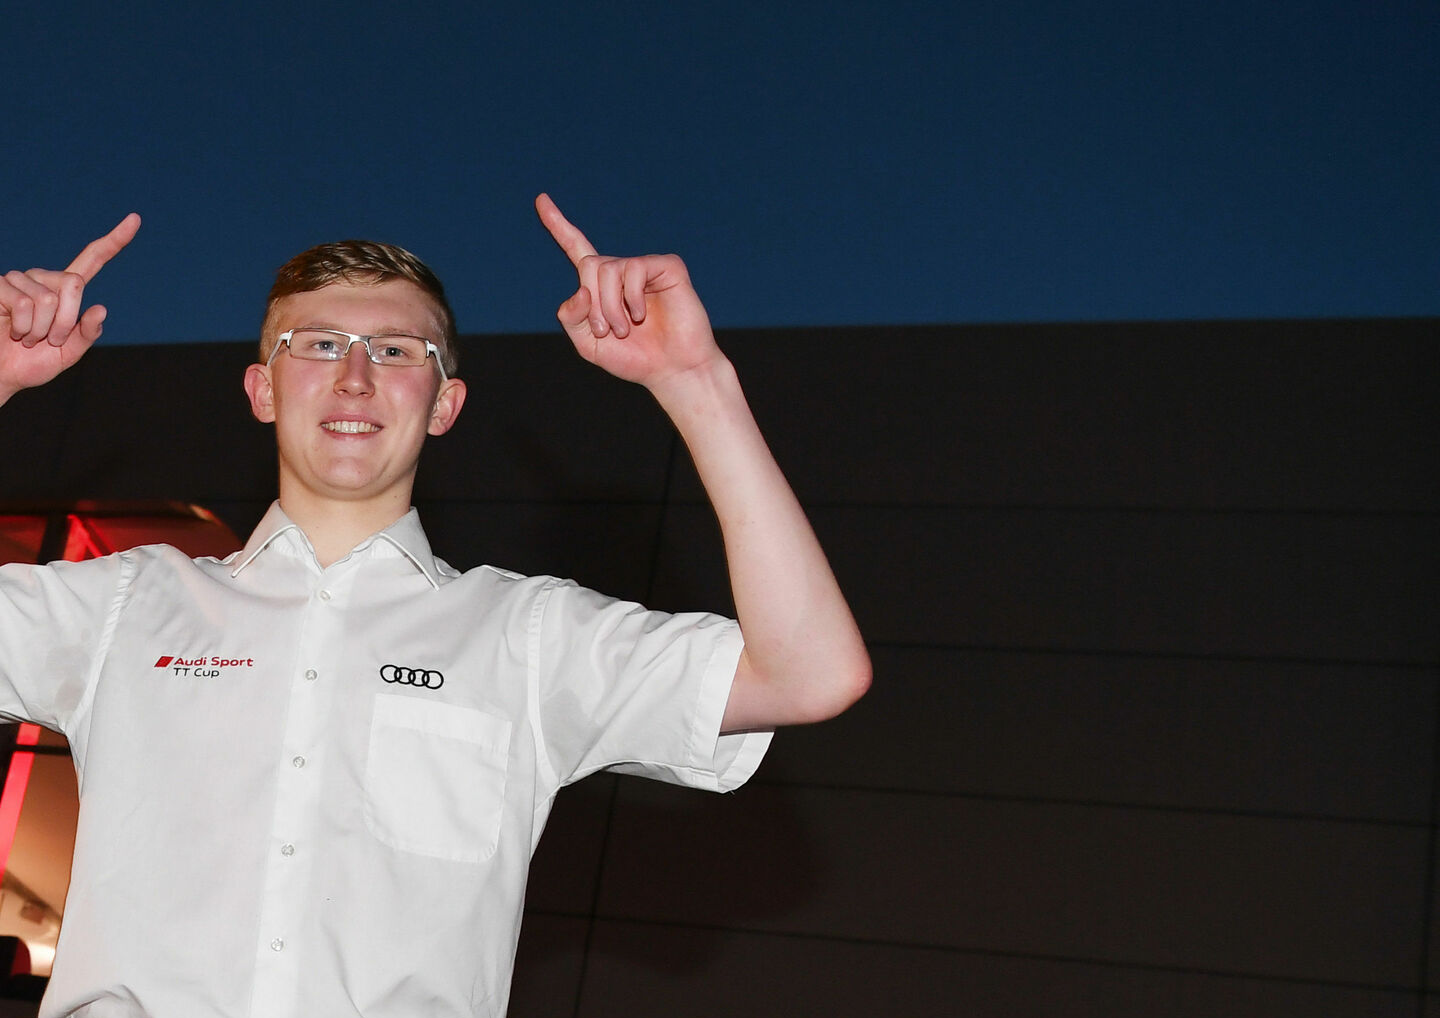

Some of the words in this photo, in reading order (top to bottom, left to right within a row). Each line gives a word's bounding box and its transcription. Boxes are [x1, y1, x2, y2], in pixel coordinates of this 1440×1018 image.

[173, 656, 208, 667] Audi
[210, 656, 254, 668] Sport
[173, 667, 191, 677] TT
[193, 667, 220, 679] Cup
